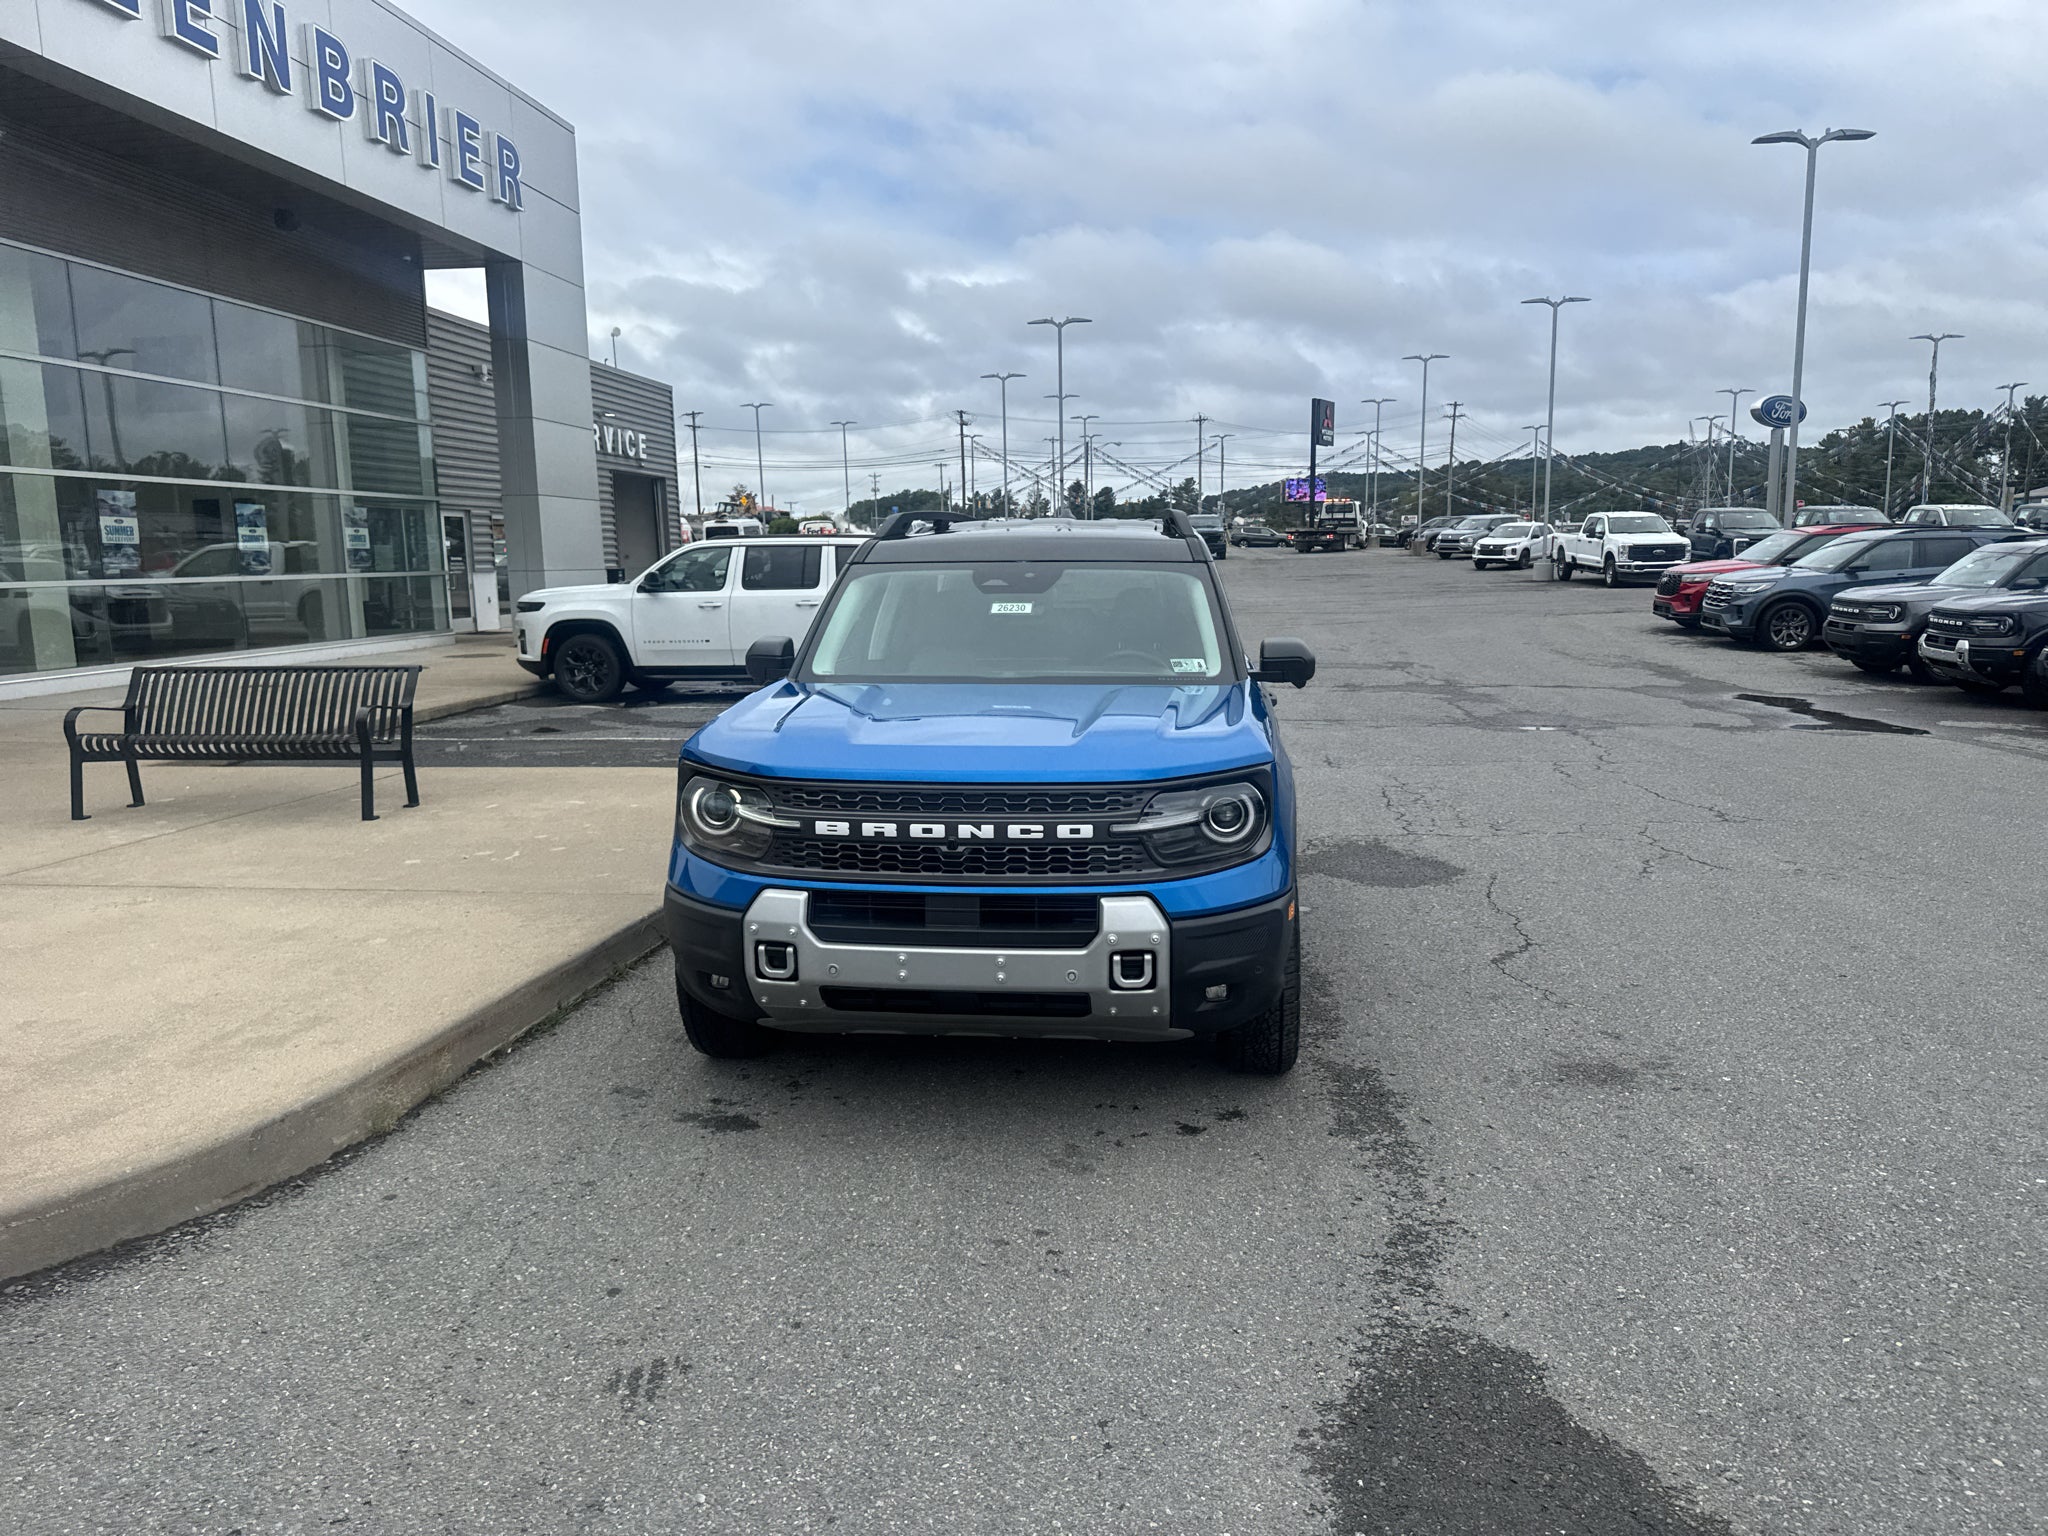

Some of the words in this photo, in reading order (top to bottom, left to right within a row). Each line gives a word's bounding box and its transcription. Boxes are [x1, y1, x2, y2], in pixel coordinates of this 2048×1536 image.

[102, 0, 525, 212] ENBRIER
[104, 525, 135, 537] SUMMER
[997, 604, 1026, 612] 26230
[1929, 616, 1963, 626] BRONCO
[815, 820, 1094, 839] BRONCO
